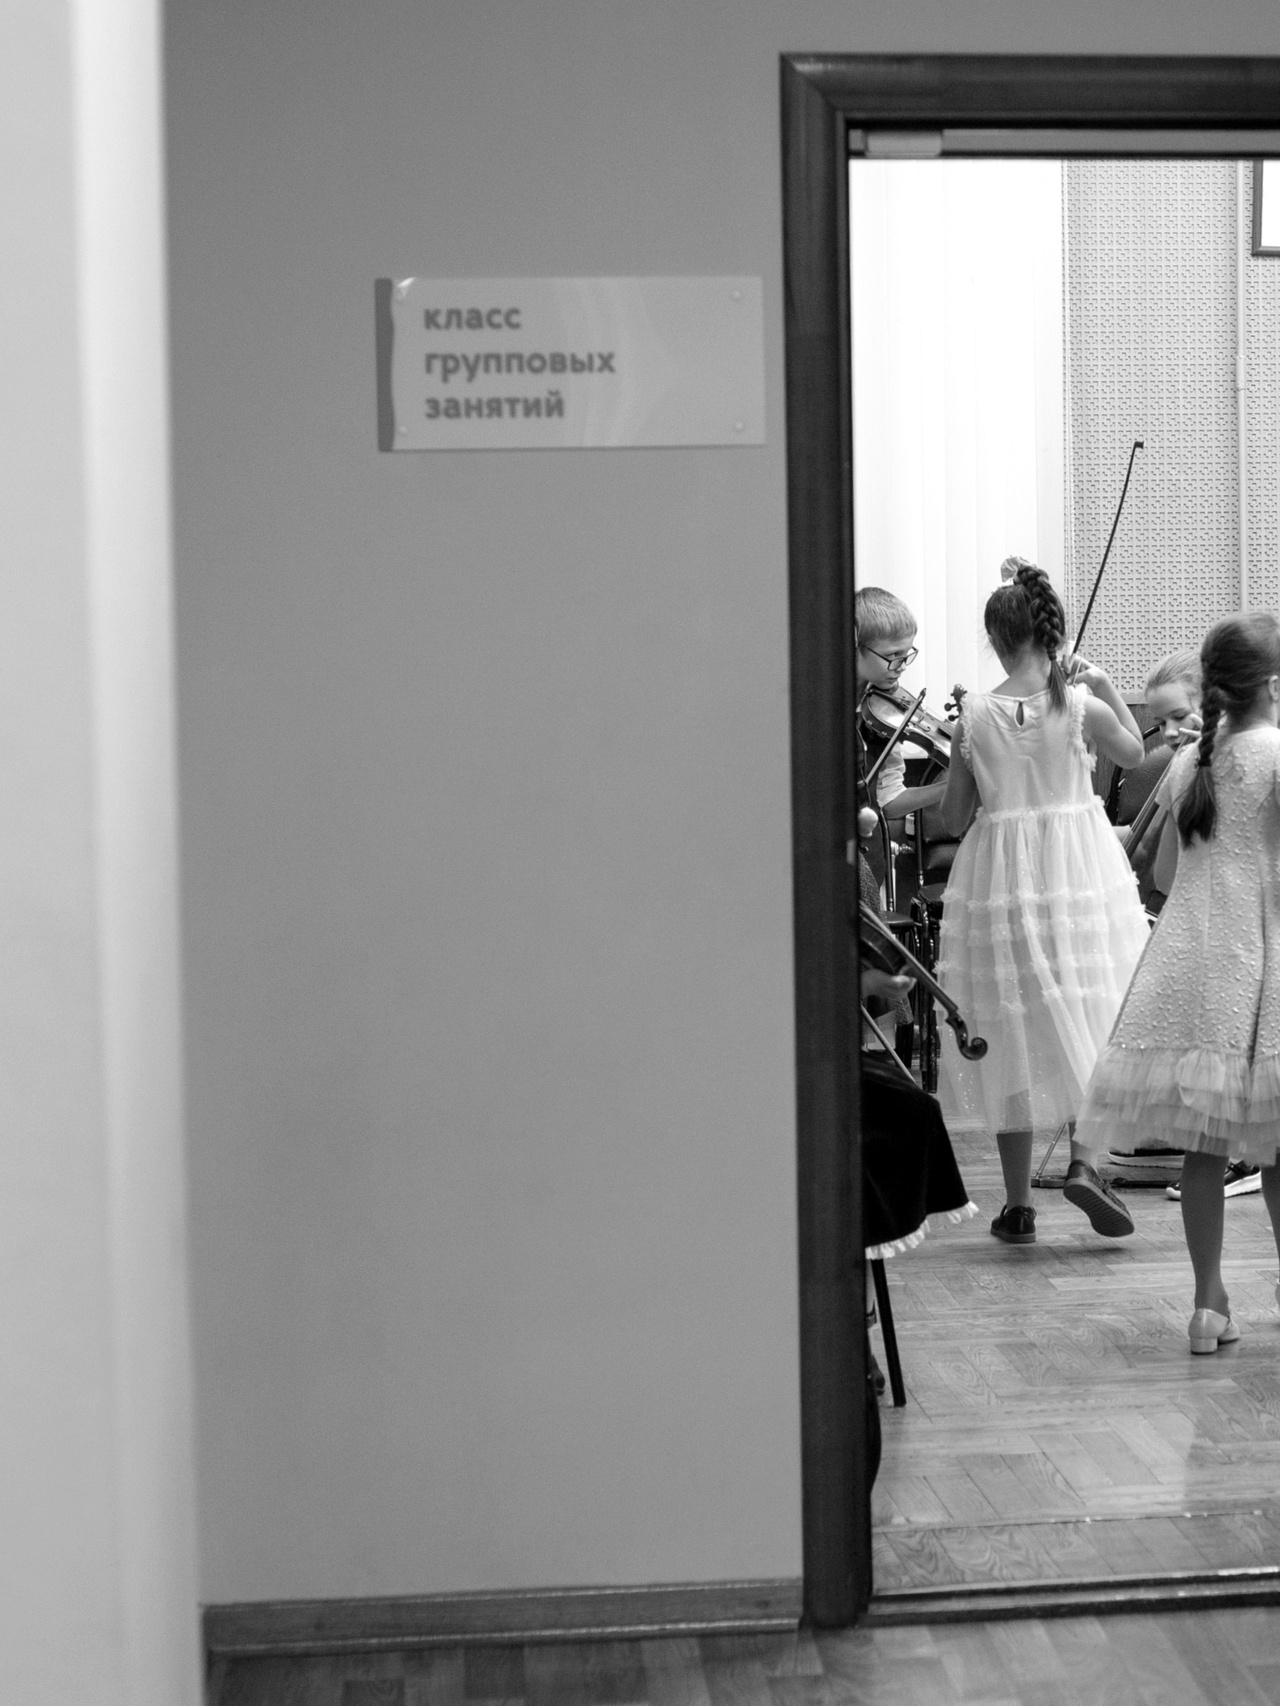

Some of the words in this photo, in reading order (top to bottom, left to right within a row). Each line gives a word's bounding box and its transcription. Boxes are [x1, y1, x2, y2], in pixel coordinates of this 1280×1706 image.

[424, 307, 521, 330] класс
[424, 351, 616, 383] групповых
[425, 390, 565, 420] занятий
